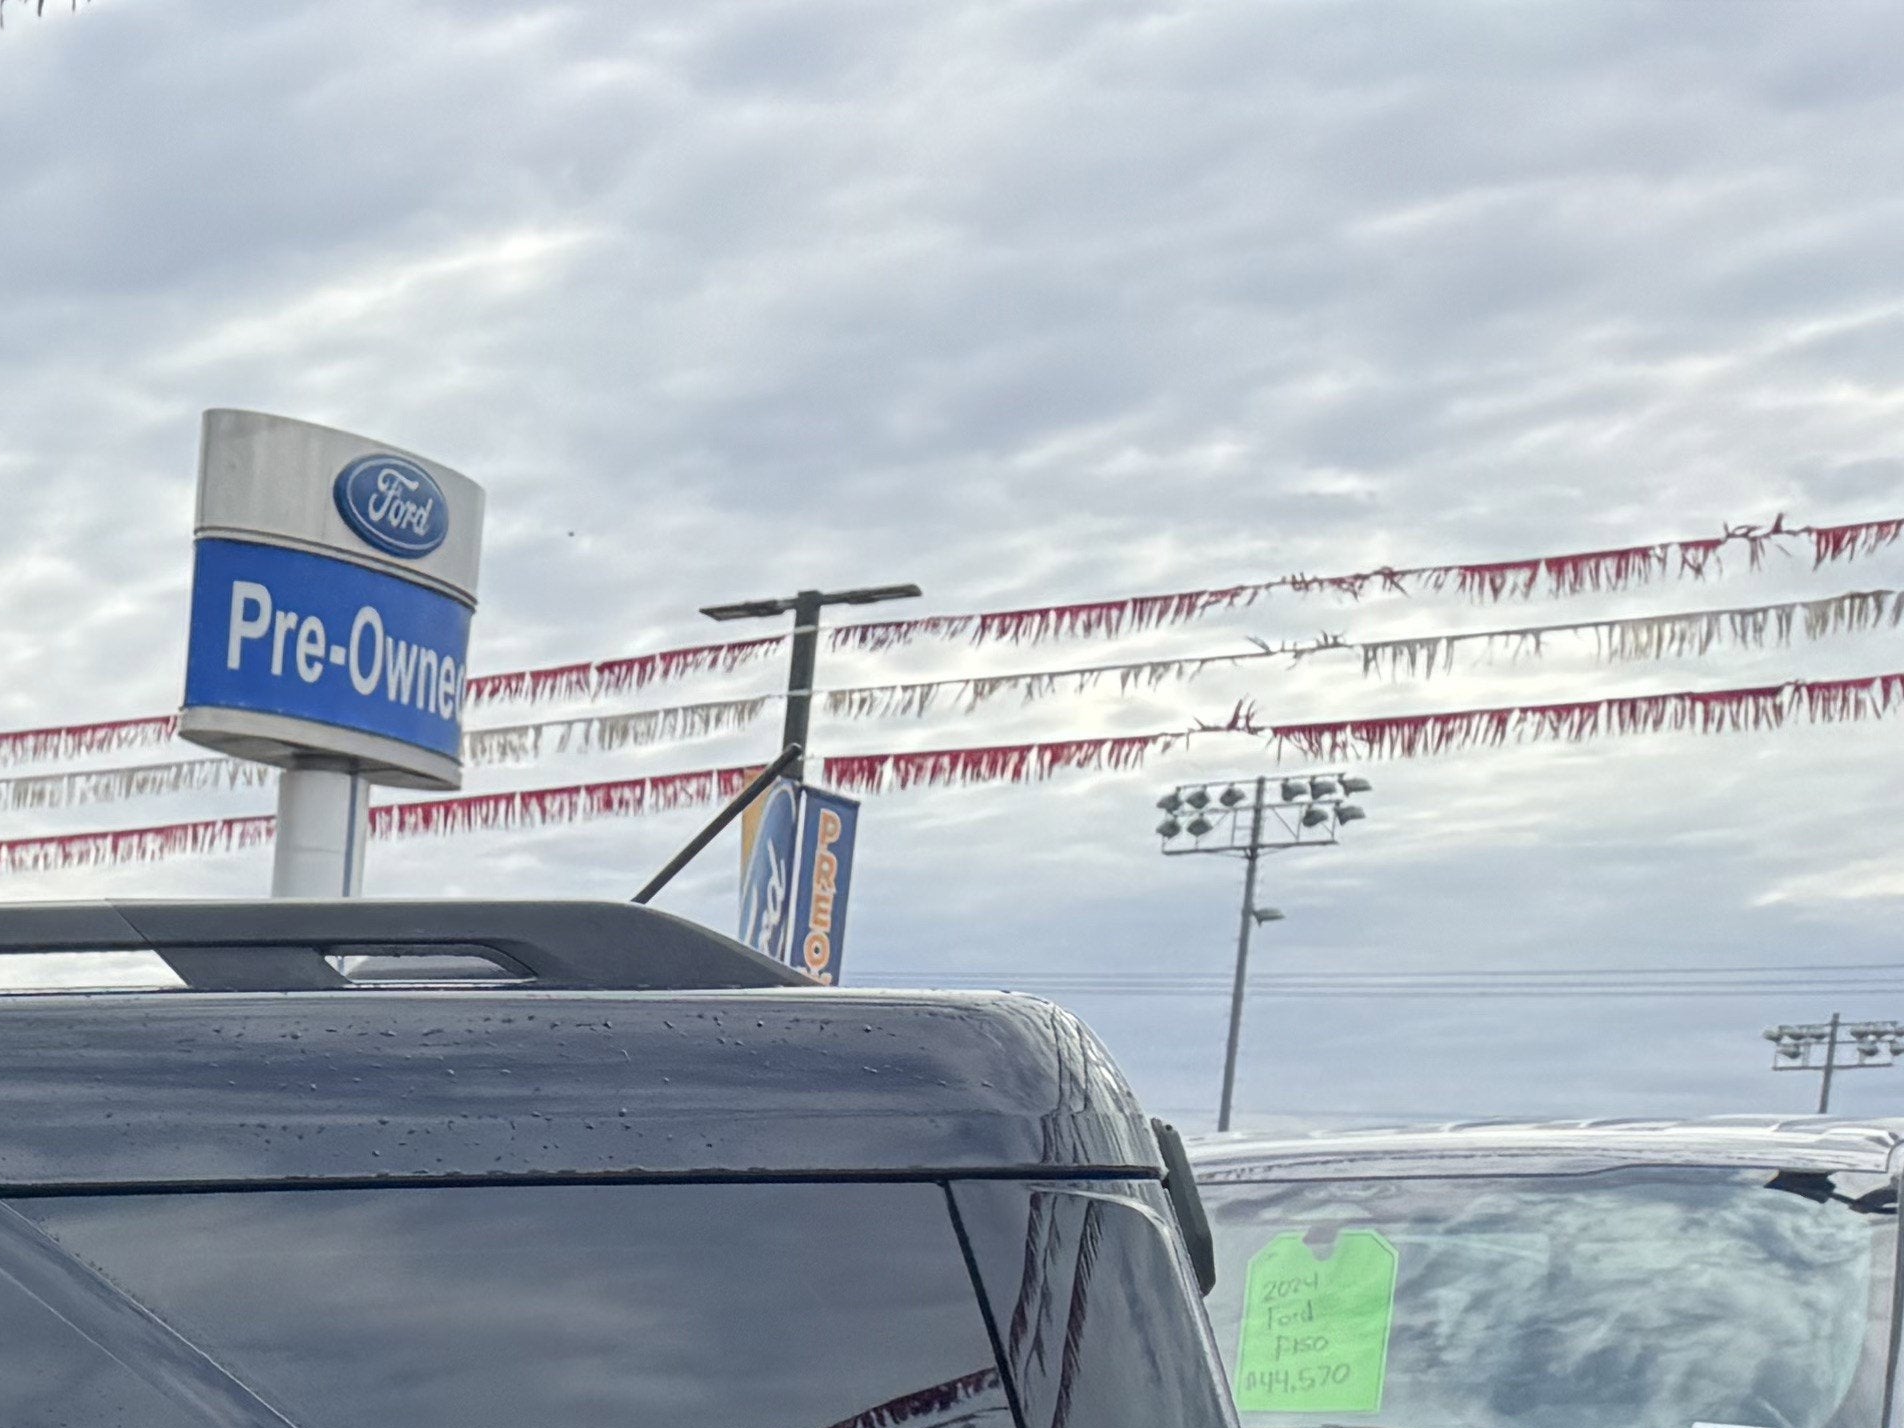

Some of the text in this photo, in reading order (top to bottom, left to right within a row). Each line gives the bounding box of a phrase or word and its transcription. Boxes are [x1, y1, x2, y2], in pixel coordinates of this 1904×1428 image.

[368, 466, 432, 537] Ford
[1262, 1271, 1319, 1303] 2024
[1267, 1299, 1315, 1331] Ford
[1274, 1334, 1330, 1362] F150
